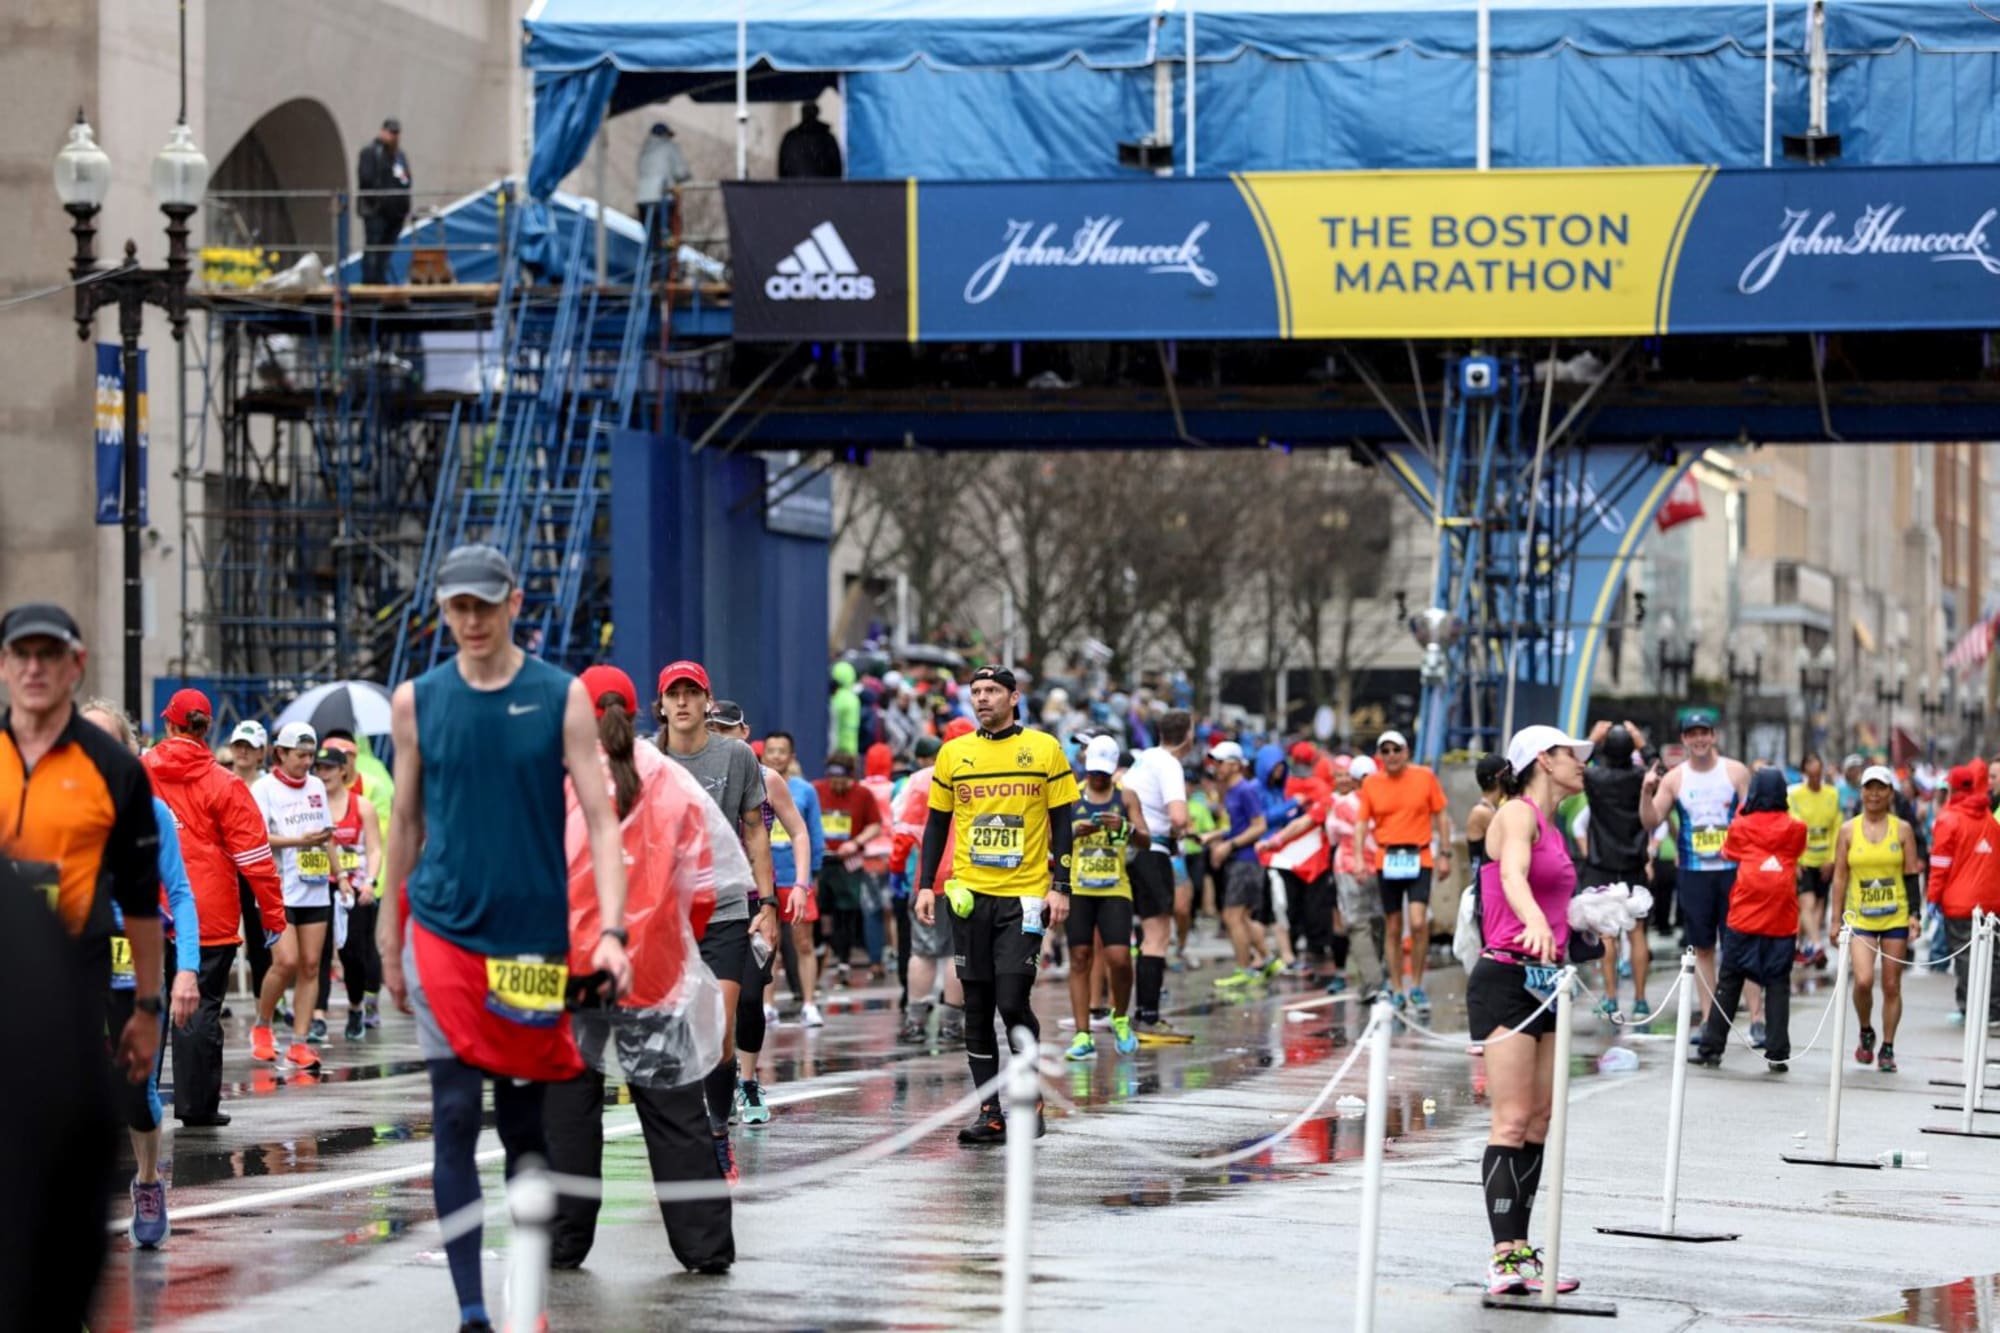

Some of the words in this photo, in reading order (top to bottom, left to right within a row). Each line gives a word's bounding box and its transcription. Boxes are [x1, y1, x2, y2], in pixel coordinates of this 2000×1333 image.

[1321, 213, 1411, 248] THE
[1431, 212, 1629, 247] BOSTON
[963, 217, 1066, 304] John
[1064, 213, 1219, 287] Hancock
[1737, 206, 1845, 294] John
[1843, 201, 2000, 275] Hancock
[765, 271, 876, 302] adidas
[1335, 257, 1614, 294] MARATHON
[974, 783, 1042, 799] EVONIK
[973, 828, 1018, 847] 29761
[1861, 887, 1894, 903] 25079
[496, 964, 562, 998] 28089
